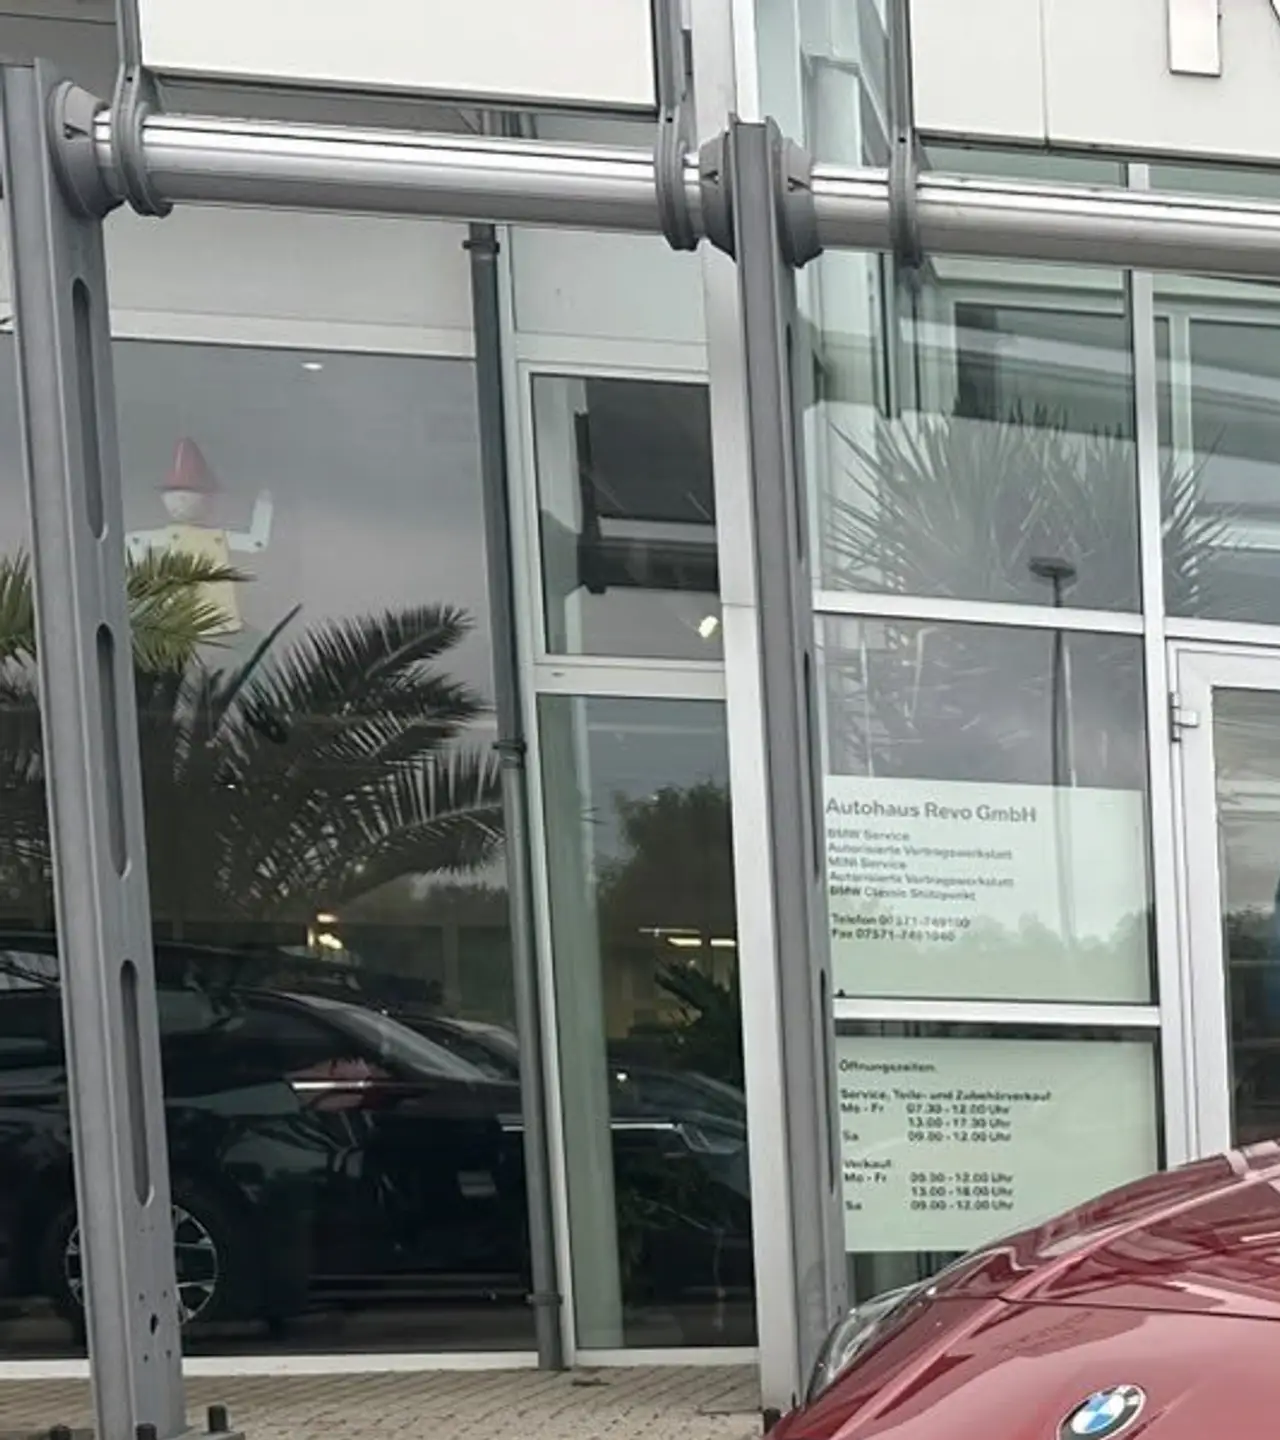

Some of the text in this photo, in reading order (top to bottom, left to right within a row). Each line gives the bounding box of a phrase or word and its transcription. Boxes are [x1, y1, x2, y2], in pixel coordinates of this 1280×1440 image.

[826, 797, 1037, 822] Autohaus Revo GmbH
[863, 830, 910, 841] Service
[861, 858, 907, 869] Service
[830, 885, 861, 896] BMW
[832, 928, 853, 939] Fax
[930, 1091, 953, 1101] und
[841, 1103, 860, 1113] Mo
[871, 1103, 884, 1113] Fr
[988, 1104, 1010, 1114] Uhr
[989, 1118, 1012, 1128] Uhr
[843, 1131, 859, 1141] Sa
[989, 1132, 1012, 1142] Uhr
[845, 1172, 864, 1182] Mo
[875, 1172, 887, 1182] Fr
[992, 1173, 1013, 1183] Uhr
[991, 1187, 1013, 1197] Uhr
[846, 1201, 862, 1210] Sa
[991, 1200, 1014, 1210] Uhr
